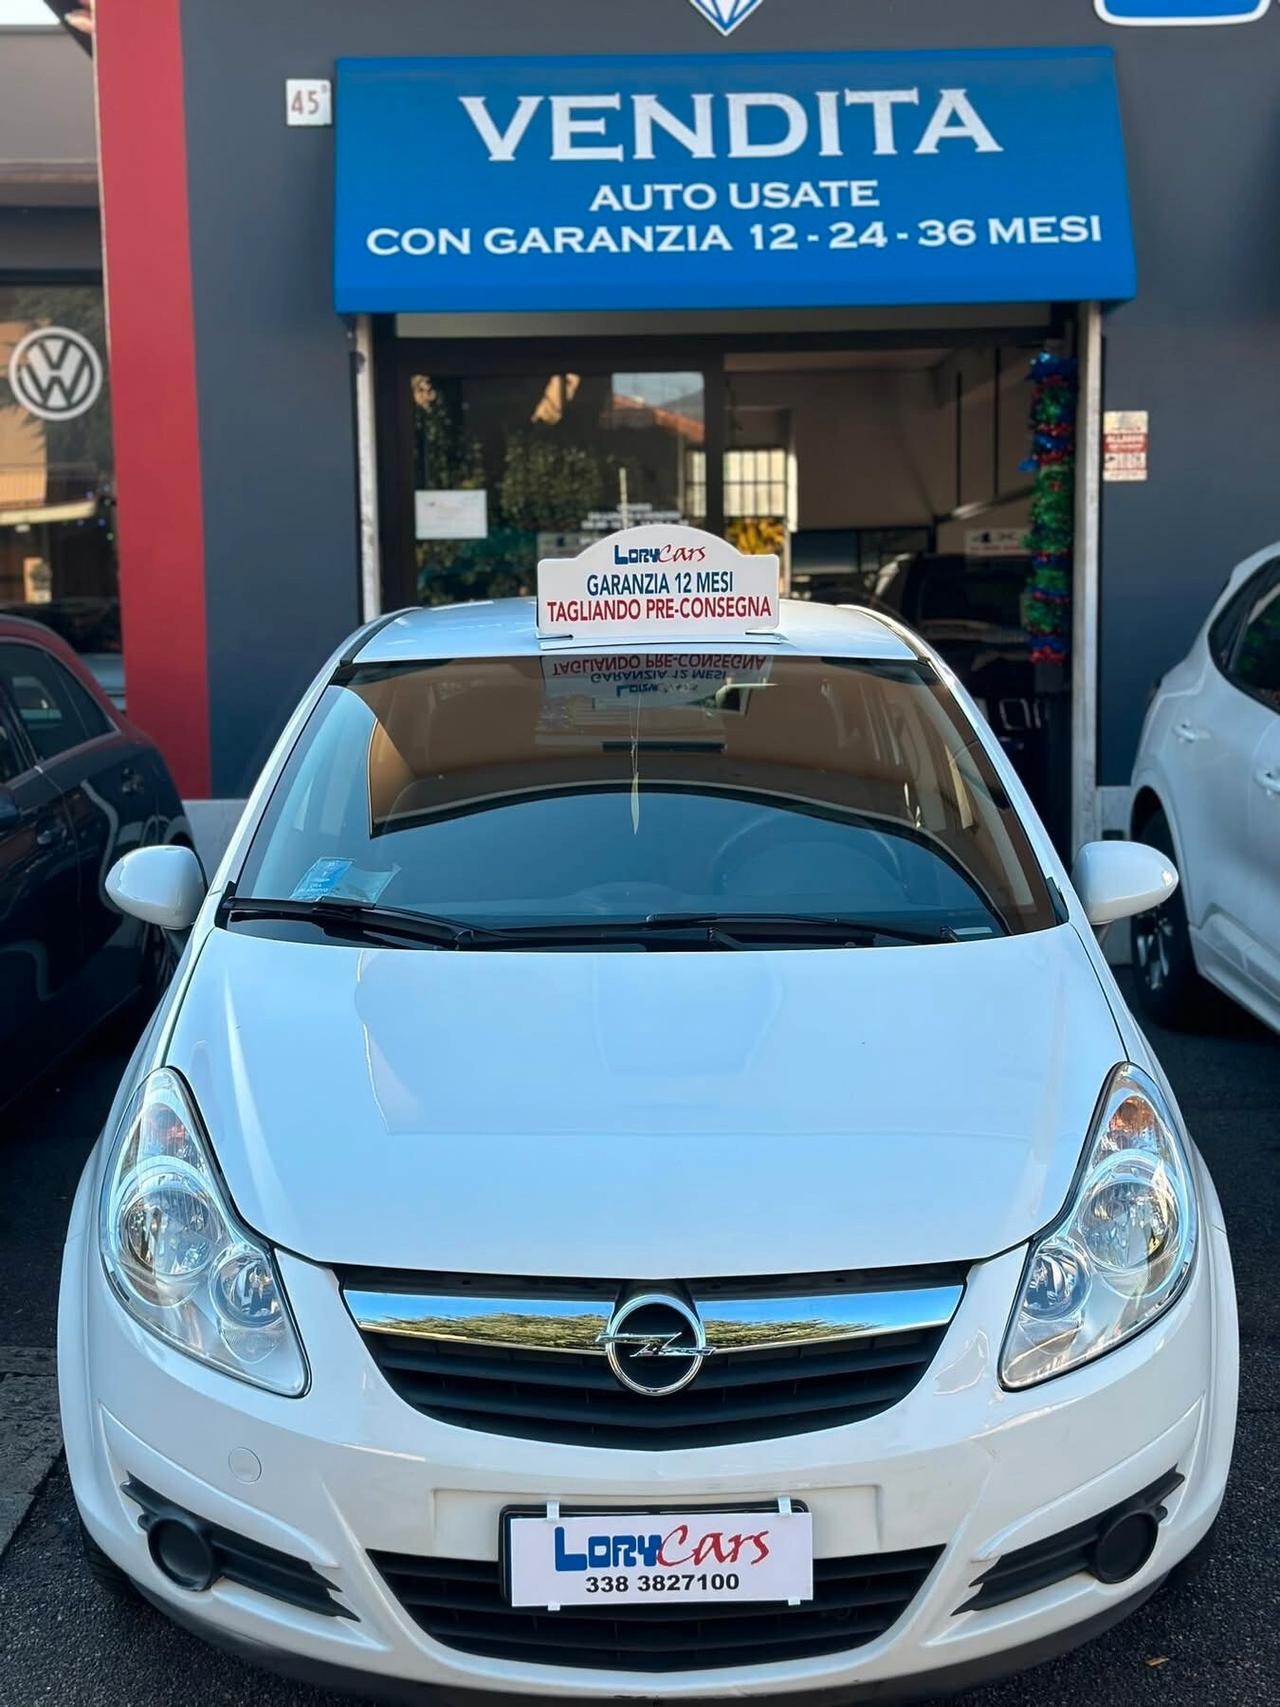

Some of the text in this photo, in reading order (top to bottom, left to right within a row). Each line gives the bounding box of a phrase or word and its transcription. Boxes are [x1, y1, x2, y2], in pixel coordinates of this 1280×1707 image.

[459, 88, 1003, 162] VENDITA
[590, 181, 880, 212] AUTO USATE
[367, 228, 470, 256] CON
[483, 223, 733, 254] GARANZIA
[750, 223, 798, 250] 12
[829, 221, 888, 249] 24
[918, 219, 976, 247] 36
[988, 215, 1101, 244] MESI
[586, 571, 734, 597] GARANZIA 12 MESI
[546, 596, 772, 622] TAGLIANDO PRE-CONSEGNA
[585, 1573, 741, 1594] 338 3827100
